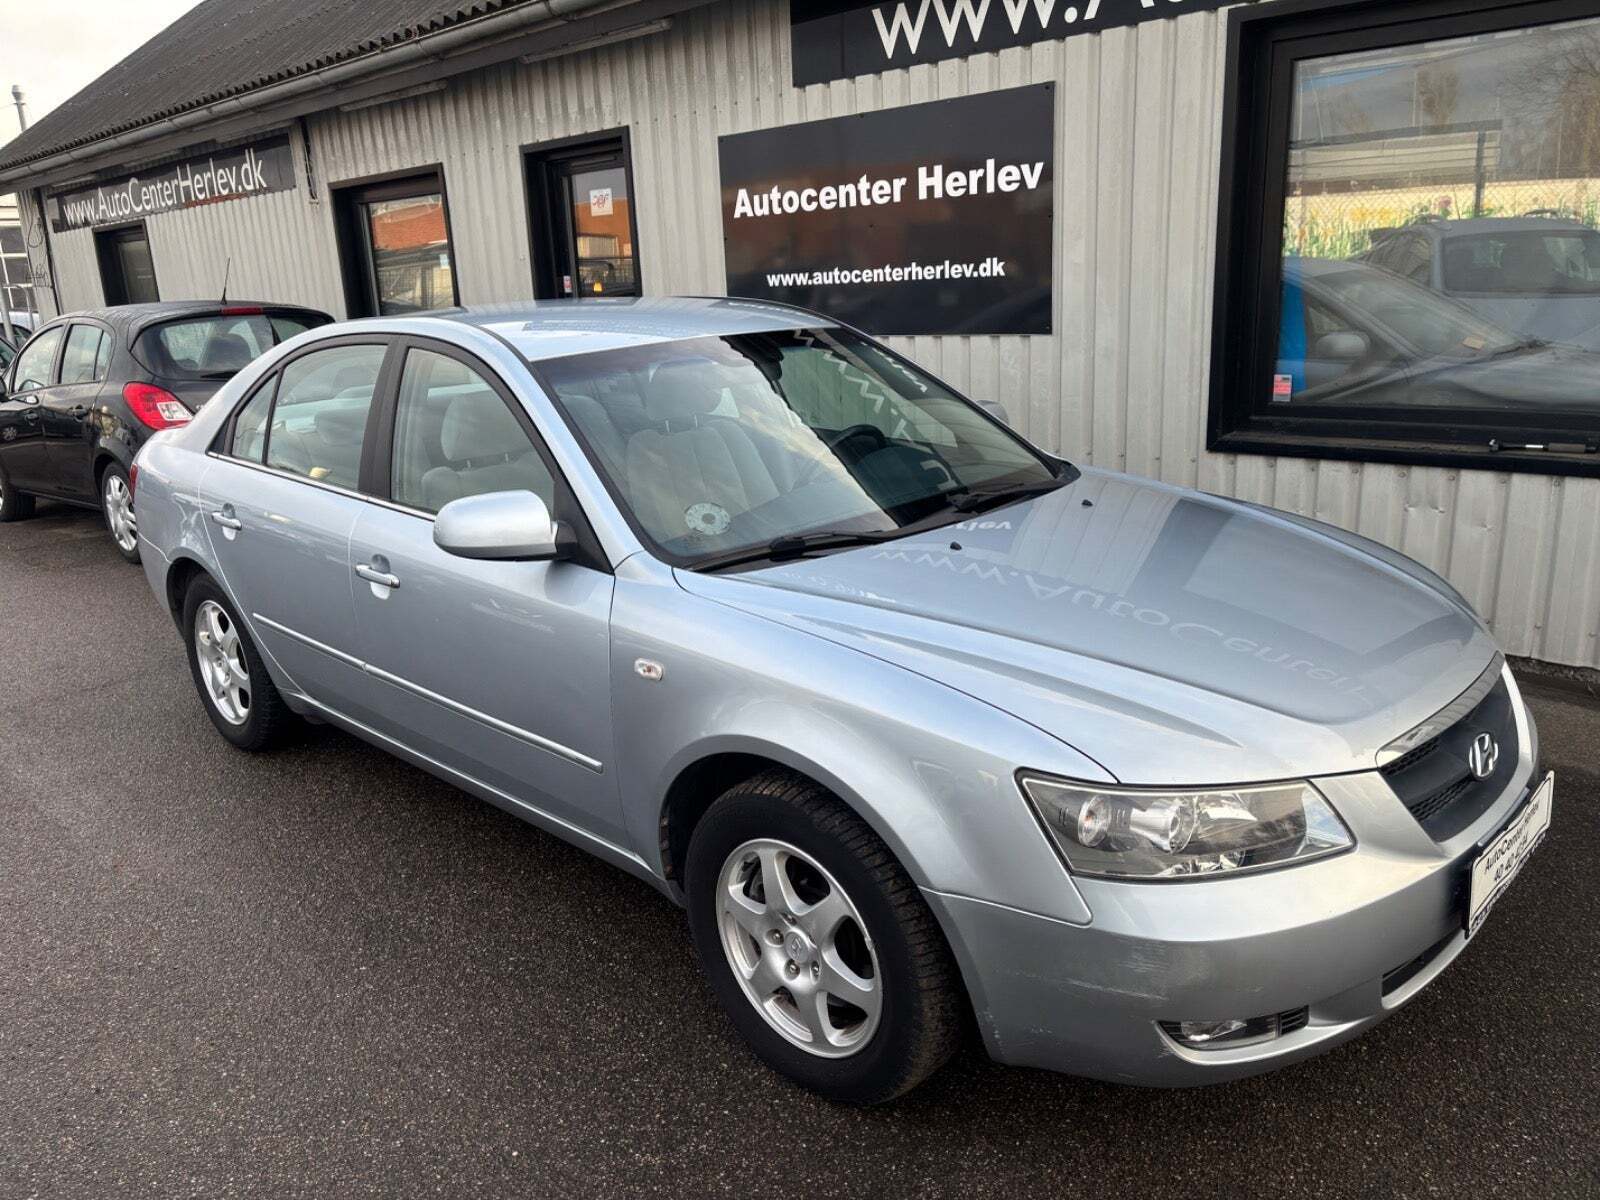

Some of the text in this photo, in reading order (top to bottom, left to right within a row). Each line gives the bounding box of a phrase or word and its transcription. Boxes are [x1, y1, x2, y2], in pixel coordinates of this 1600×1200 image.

[63, 148, 267, 226] www.AutoCenterHerlev.dk
[733, 158, 1044, 218] Autocenter Herlev
[766, 257, 1006, 287] www.autocenterherlev.dk
